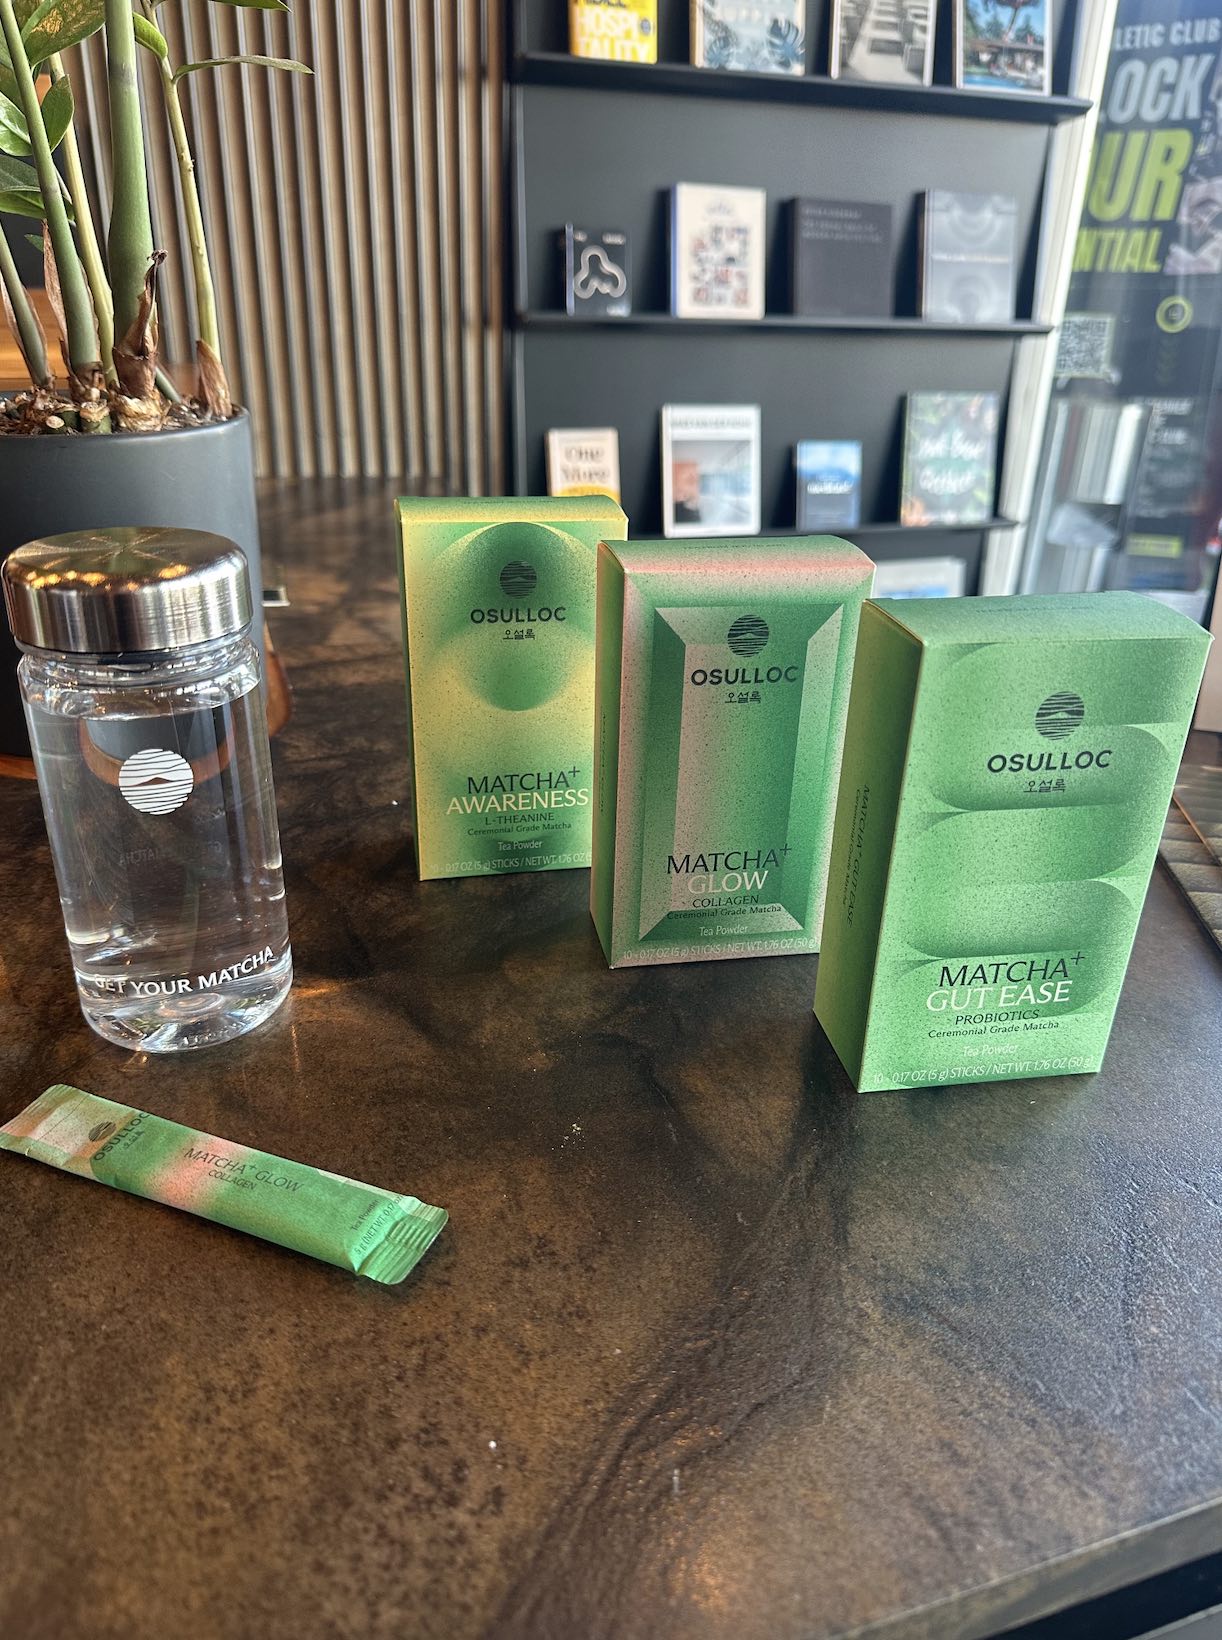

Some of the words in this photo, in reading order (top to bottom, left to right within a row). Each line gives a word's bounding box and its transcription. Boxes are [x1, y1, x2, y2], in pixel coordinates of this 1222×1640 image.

[1170, 17, 1221, 46] CLUB
[470, 606, 567, 624] OSULLOC
[503, 628, 536, 641] 오설록
[690, 665, 800, 686] OSULLOC
[725, 690, 761, 704] 오설록
[987, 749, 1113, 774] OSULLOC
[1023, 778, 1067, 793] 오설록
[446, 788, 590, 816] AWARENESS
[485, 812, 555, 826] L-THEANINE
[467, 825, 514, 836] Ceremonial
[516, 824, 541, 833] Grade
[542, 821, 572, 831] Matcha
[498, 841, 512, 851] Tea
[513, 839, 543, 850] Powder
[460, 861, 473, 871] OZ
[491, 857, 519, 869] STICKS
[525, 856, 542, 867] NET
[687, 870, 769, 894] GLOW
[692, 894, 760, 909] COLLAGEN
[666, 909, 718, 920] Ceremonial
[720, 906, 747, 917] Grade
[750, 904, 782, 914] Matcha
[699, 925, 714, 936] Tea
[716, 924, 749, 936] Powder
[655, 948, 670, 958] OZ
[690, 945, 721, 956] STICKS
[727, 942, 745, 954] NET
[780, 939, 795, 950] OZ
[130, 978, 193, 996] YOUR
[198, 945, 274, 990] MATCHA
[926, 987, 993, 1012] GUT
[998, 980, 1073, 1008] EASE
[955, 1009, 1040, 1026] PROBIOTICS
[928, 1026, 987, 1039] Ceremonial
[989, 1023, 1020, 1034] Grade
[1023, 1021, 1060, 1032] Matcha
[963, 1045, 979, 1057] Tea
[982, 1043, 1018, 1056] Powder
[911, 1070, 927, 1082] OZ
[950, 1064, 986, 1079] STICKS
[992, 1062, 1014, 1074] NET
[1052, 1057, 1067, 1069] OZ
[1068, 1056, 1083, 1069] (50
[208, 1168, 257, 1191] COLLAGEN
[255, 1169, 304, 1192] GLOW
